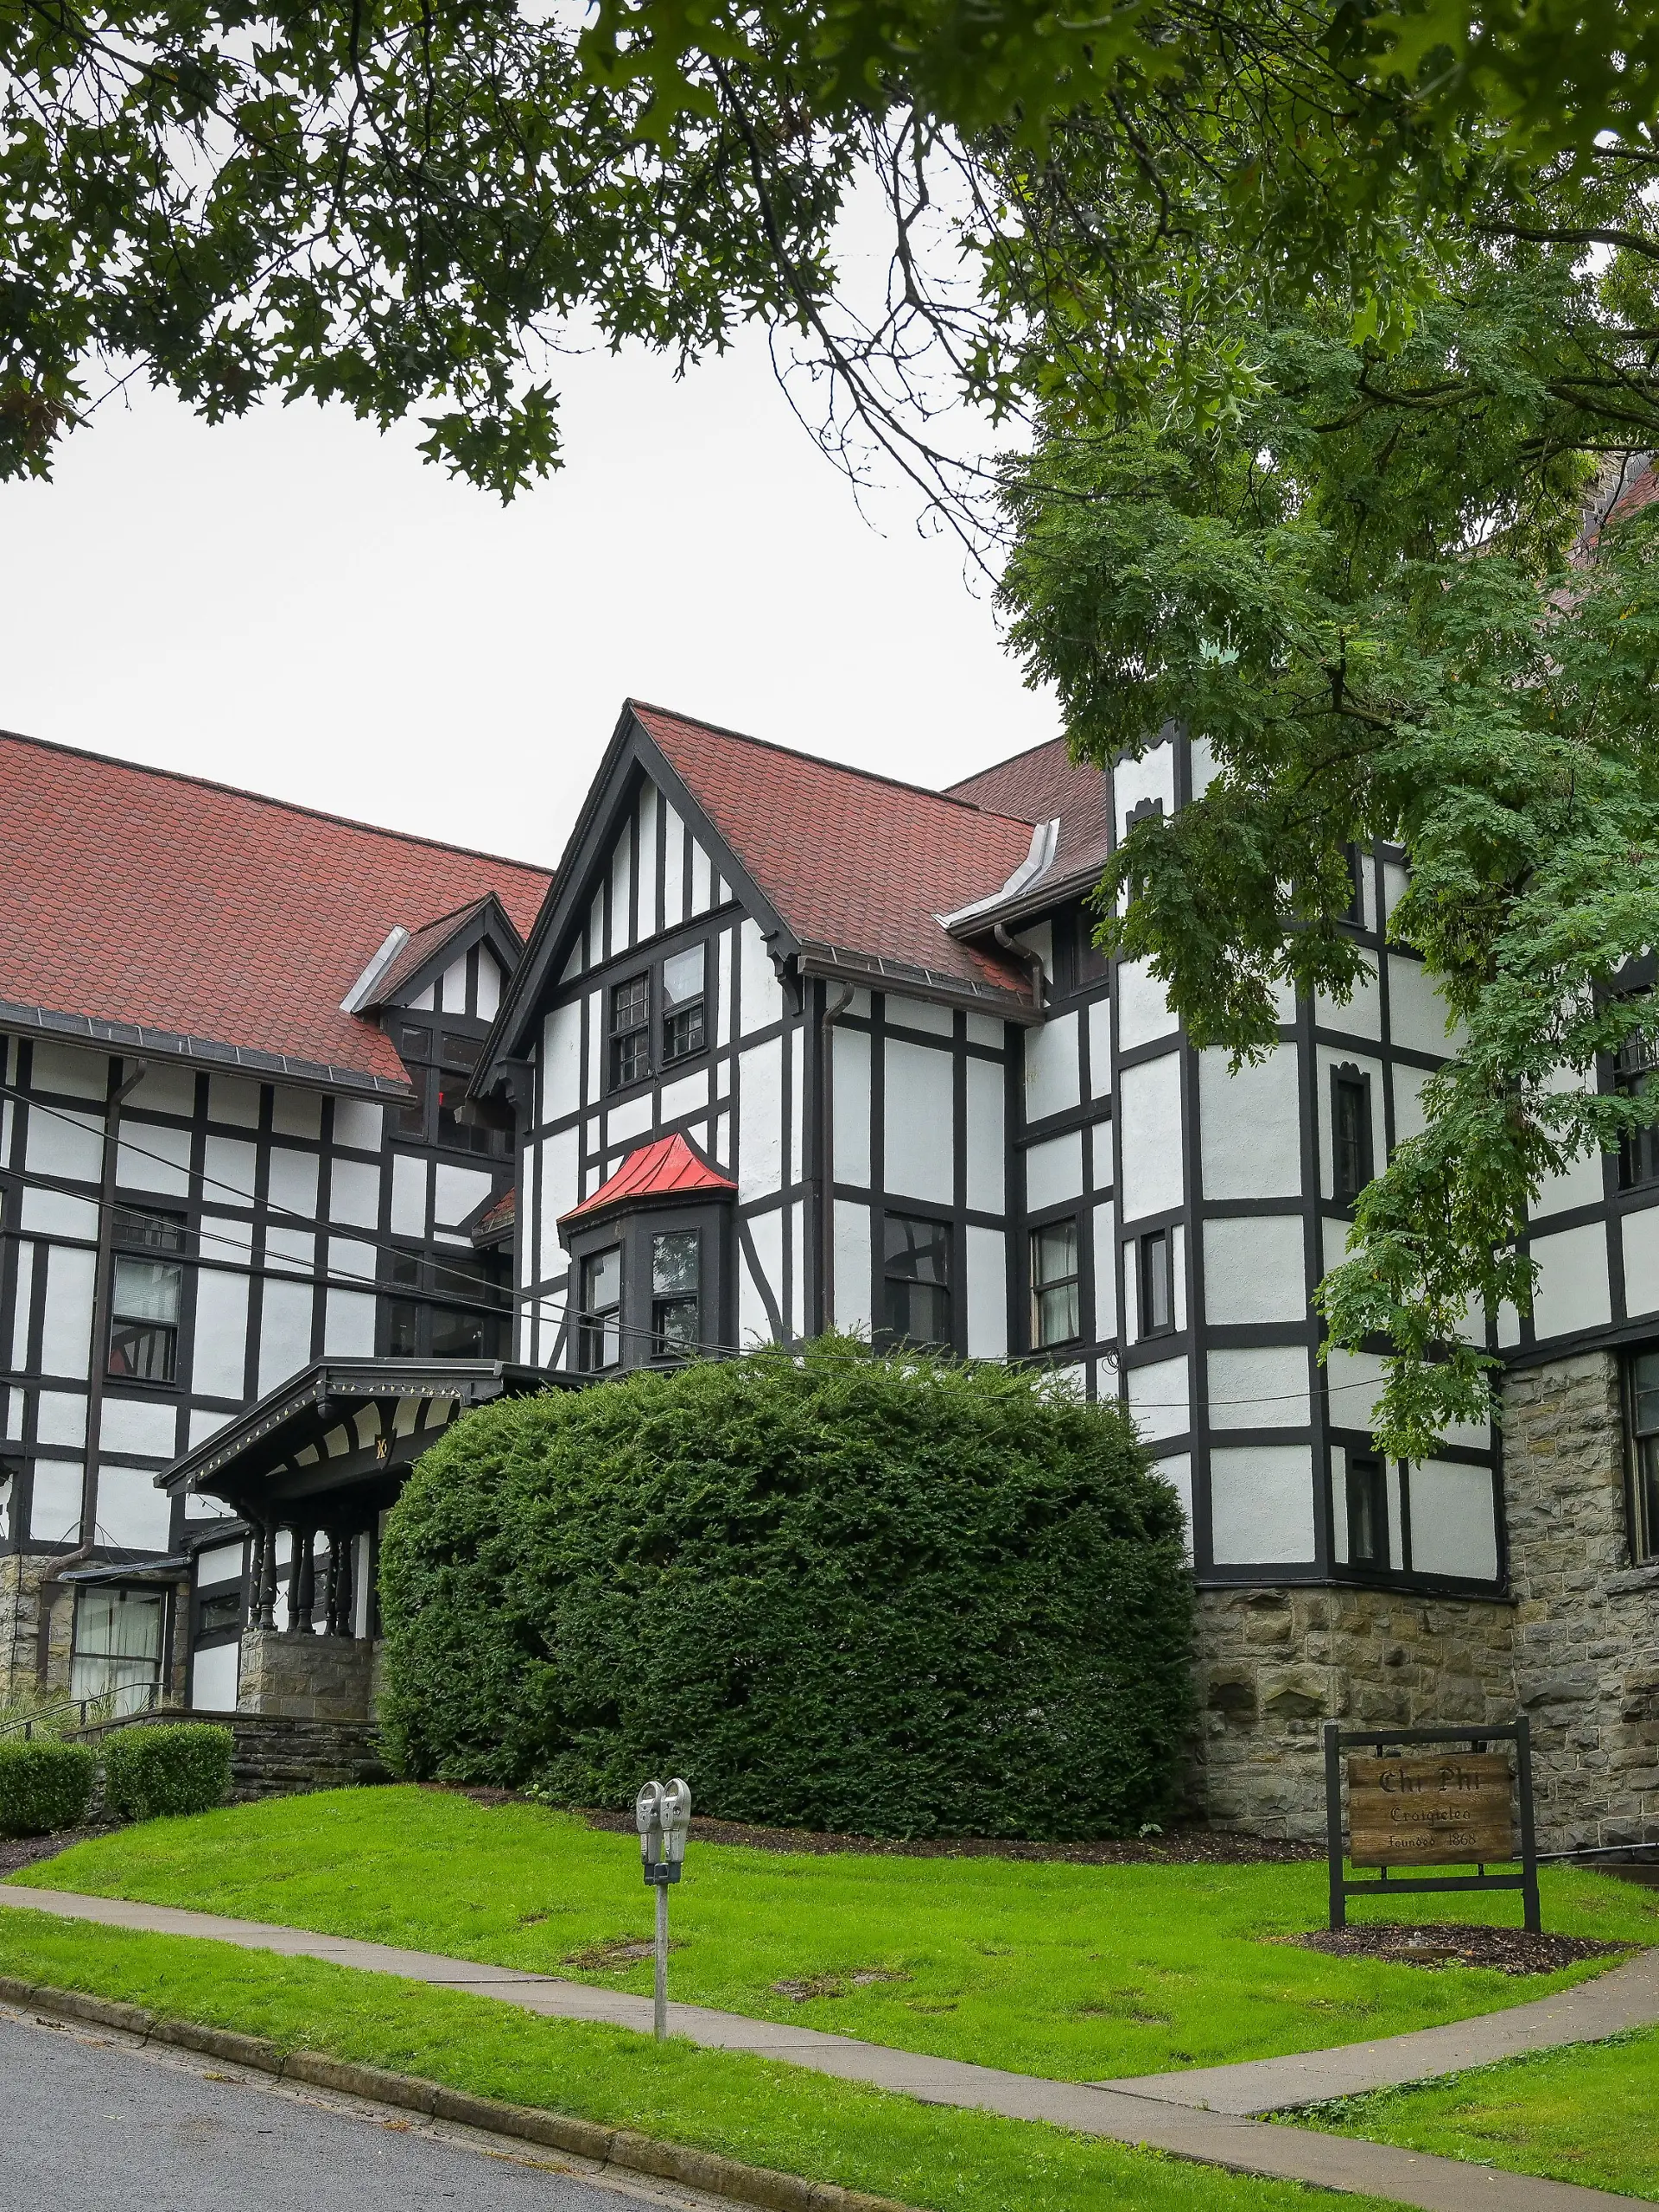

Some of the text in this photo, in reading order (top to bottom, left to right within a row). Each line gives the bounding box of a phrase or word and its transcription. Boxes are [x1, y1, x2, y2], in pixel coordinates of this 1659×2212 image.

[1378, 1766, 1480, 1793] Chi Phi
[1449, 1831, 1477, 1846] 1868
